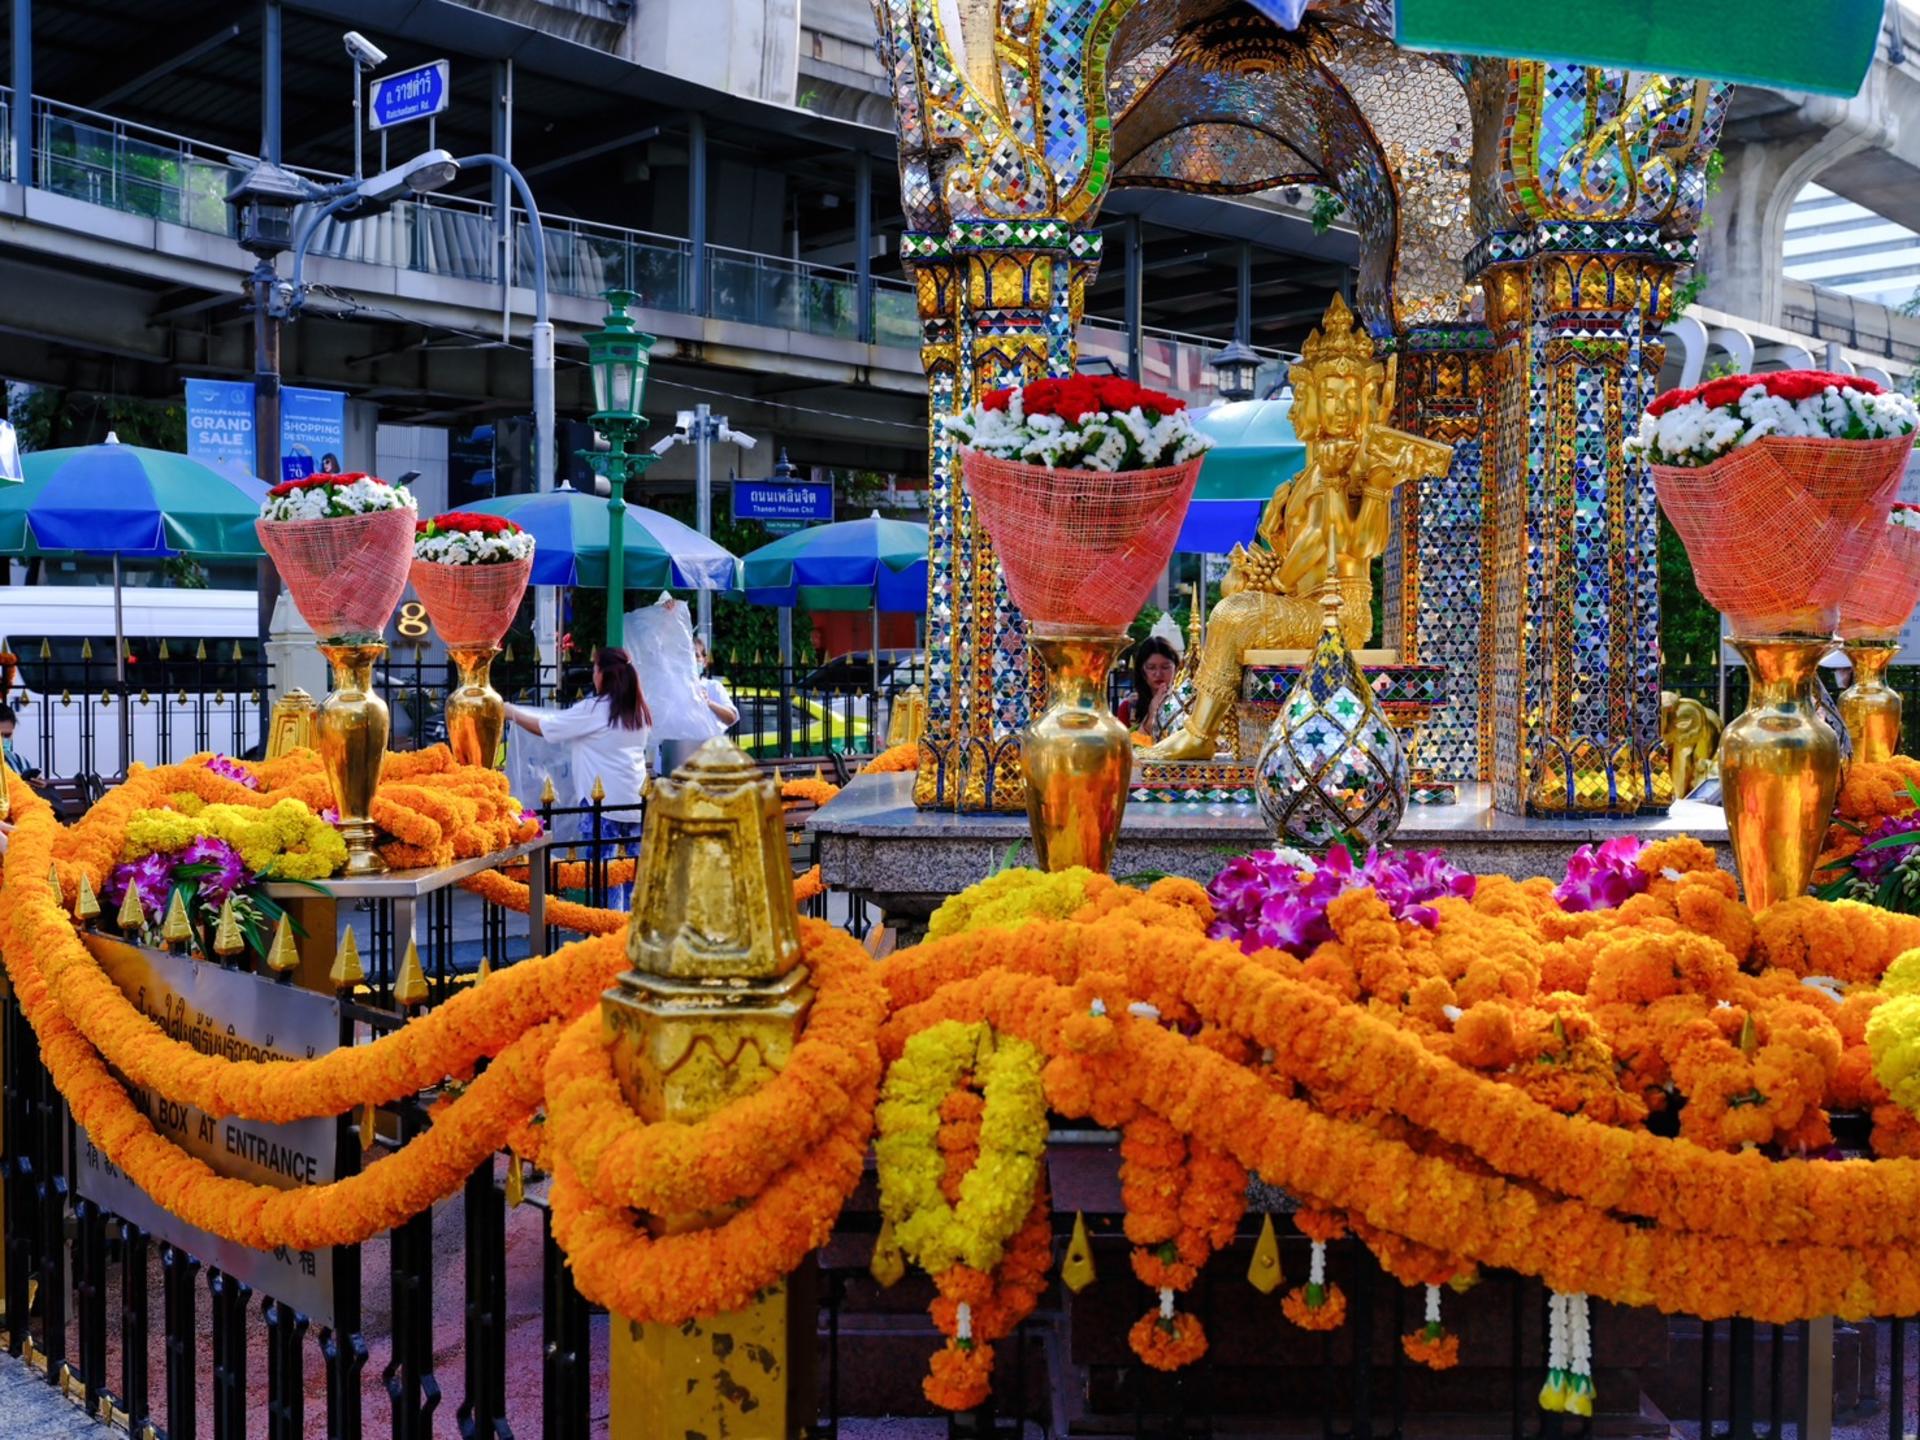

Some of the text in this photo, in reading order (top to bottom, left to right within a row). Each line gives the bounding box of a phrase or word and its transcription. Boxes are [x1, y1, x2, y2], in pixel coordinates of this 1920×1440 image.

[191, 416, 252, 432] GRAND
[283, 420, 340, 435] SHOPPING
[199, 431, 243, 446] SALE
[284, 433, 340, 444] DESTINATION
[751, 489, 816, 503] ถนนเพลินจิต
[159, 1097, 188, 1135] BOX
[199, 1114, 216, 1145] AT
[226, 1125, 317, 1185] ENTRANCE
